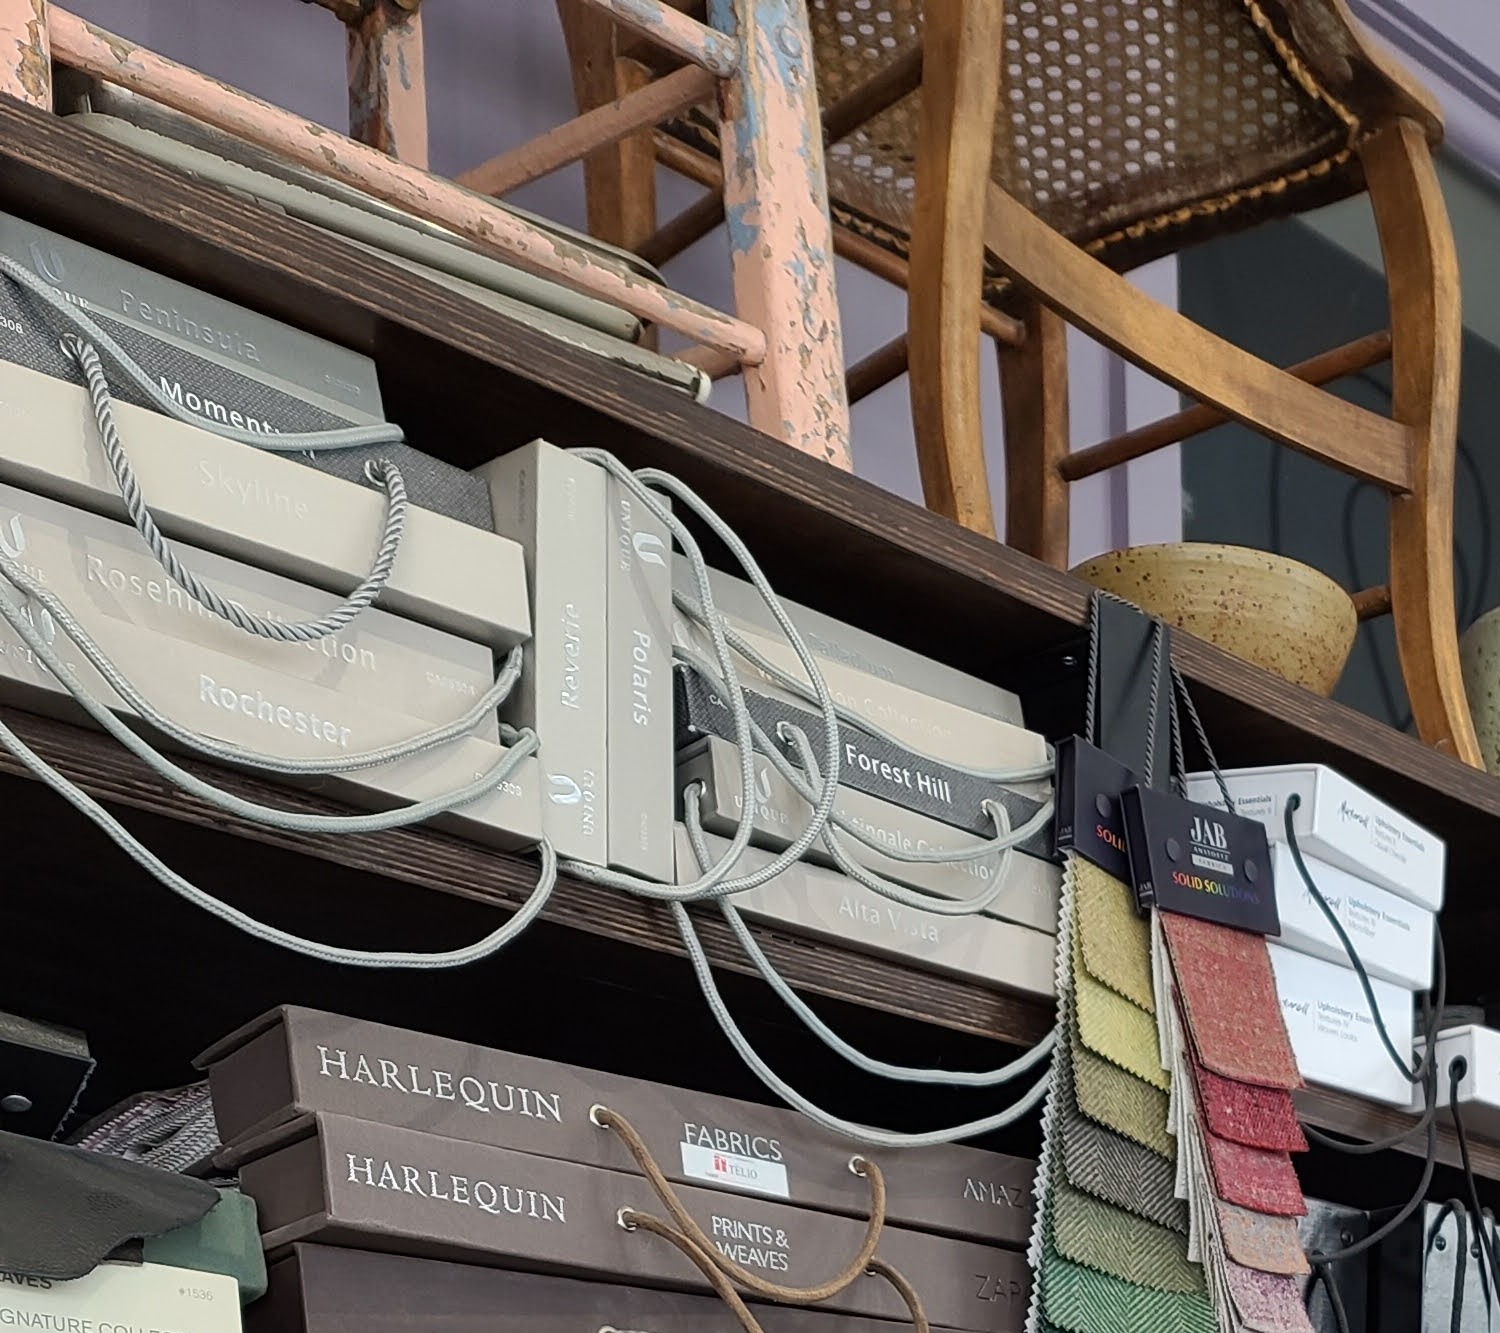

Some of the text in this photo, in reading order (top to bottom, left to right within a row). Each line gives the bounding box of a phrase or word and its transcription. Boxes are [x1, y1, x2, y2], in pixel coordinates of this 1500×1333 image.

[119, 288, 261, 362] Peninsula
[197, 459, 310, 519] Skyline
[561, 603, 581, 709] Reverie
[632, 630, 653, 726] Polaris
[199, 674, 352, 749] Rochester
[844, 744, 952, 804] Forest Hill
[1096, 824, 1127, 853] SOLI
[1189, 816, 1228, 849] JAB
[839, 896, 881, 925] Alta
[1172, 871, 1260, 904] SOLID SOLUTIONS
[316, 1045, 562, 1123] HARLEQUIN
[684, 1122, 783, 1161] FABRICS
[346, 1153, 566, 1224] HARLEQUIN
[729, 1165, 758, 1179] TELIO
[712, 1216, 790, 1249] PRINTS &
[716, 1241, 788, 1271] WEAVES
